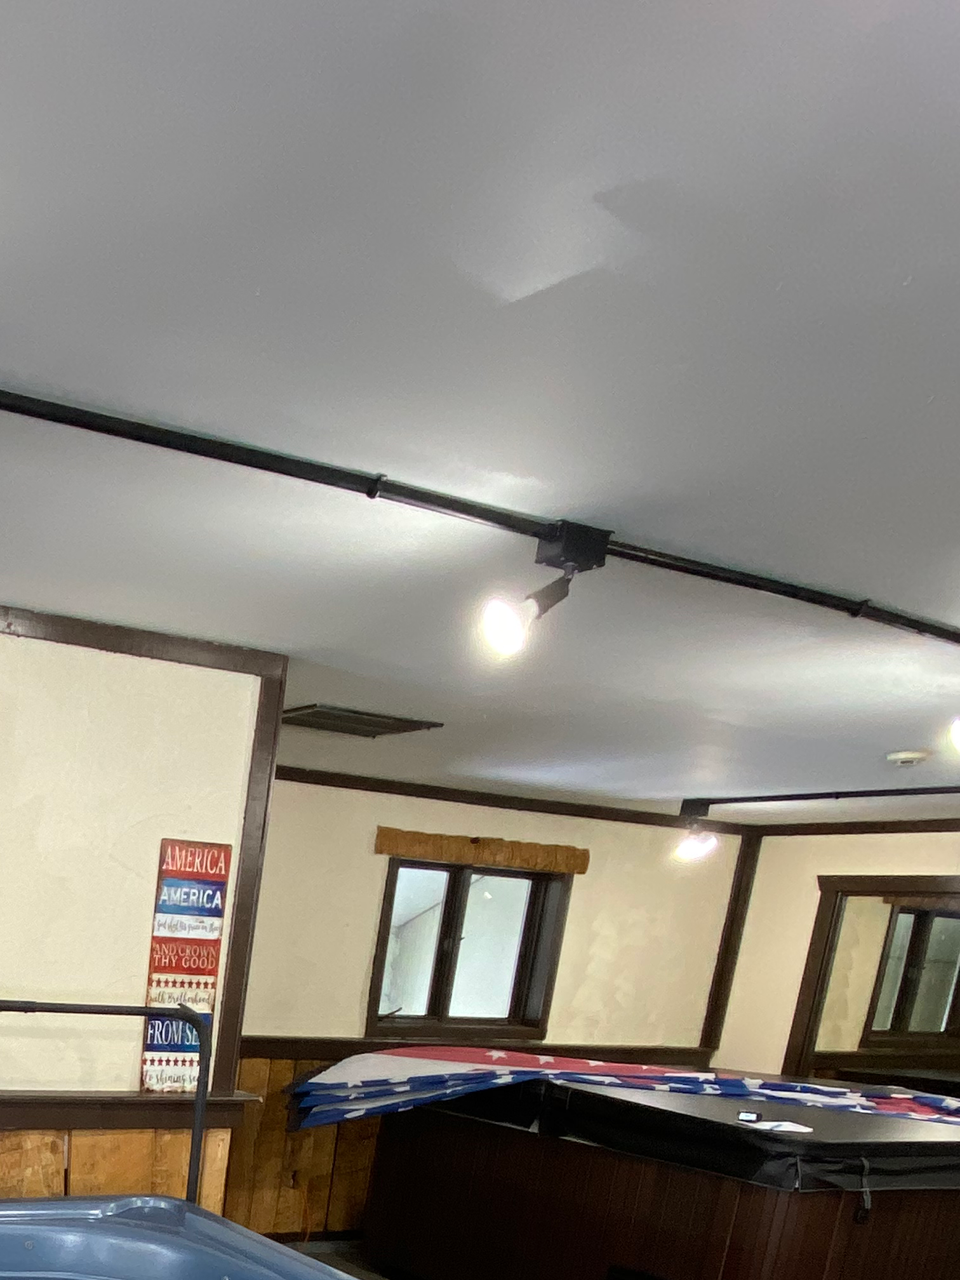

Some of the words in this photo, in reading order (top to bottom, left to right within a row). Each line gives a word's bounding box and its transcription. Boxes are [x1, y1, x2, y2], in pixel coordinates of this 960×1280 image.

[162, 845, 226, 875] AMERICA
[159, 886, 222, 909] AMERICA
[153, 943, 176, 956] AND
[178, 945, 217, 958] CROWN
[153, 954, 178, 967] THY
[182, 956, 216, 969] GOOD
[147, 1020, 183, 1045] FROM
[185, 1022, 200, 1045] SE
